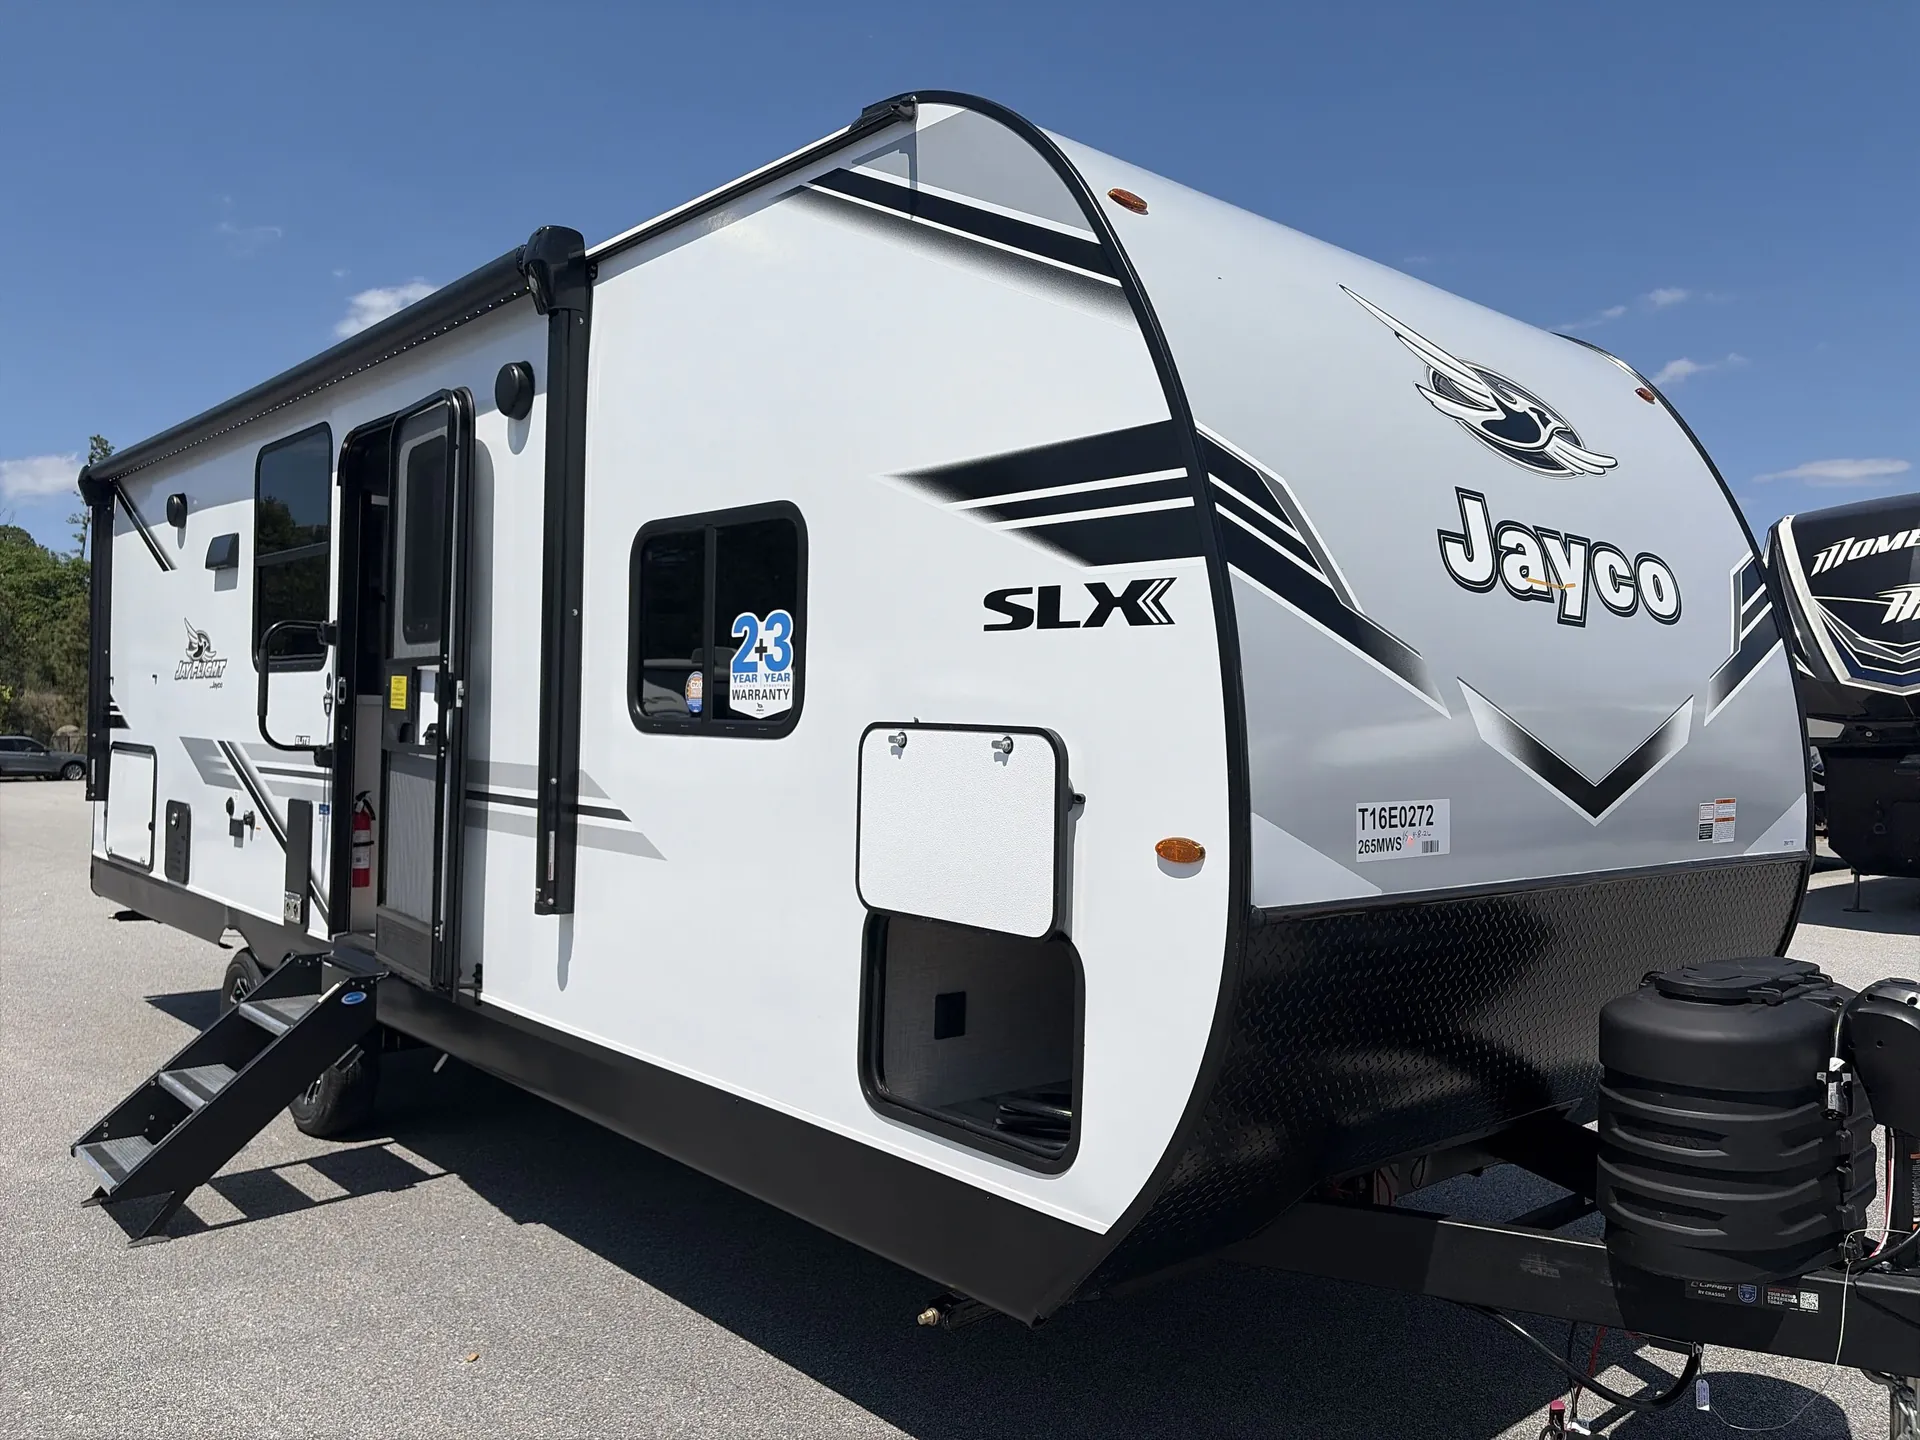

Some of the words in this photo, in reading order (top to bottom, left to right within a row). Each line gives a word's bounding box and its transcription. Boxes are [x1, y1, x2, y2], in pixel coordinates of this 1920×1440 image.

[1437, 486, 1682, 628] Jayco
[983, 577, 1178, 631] SLX
[732, 674, 758, 683] YEAR
[764, 672, 790, 682] YEAR
[732, 688, 790, 701] WARRANTY
[1358, 804, 1434, 831] T16E0272
[1358, 836, 1402, 855] 265MWS
